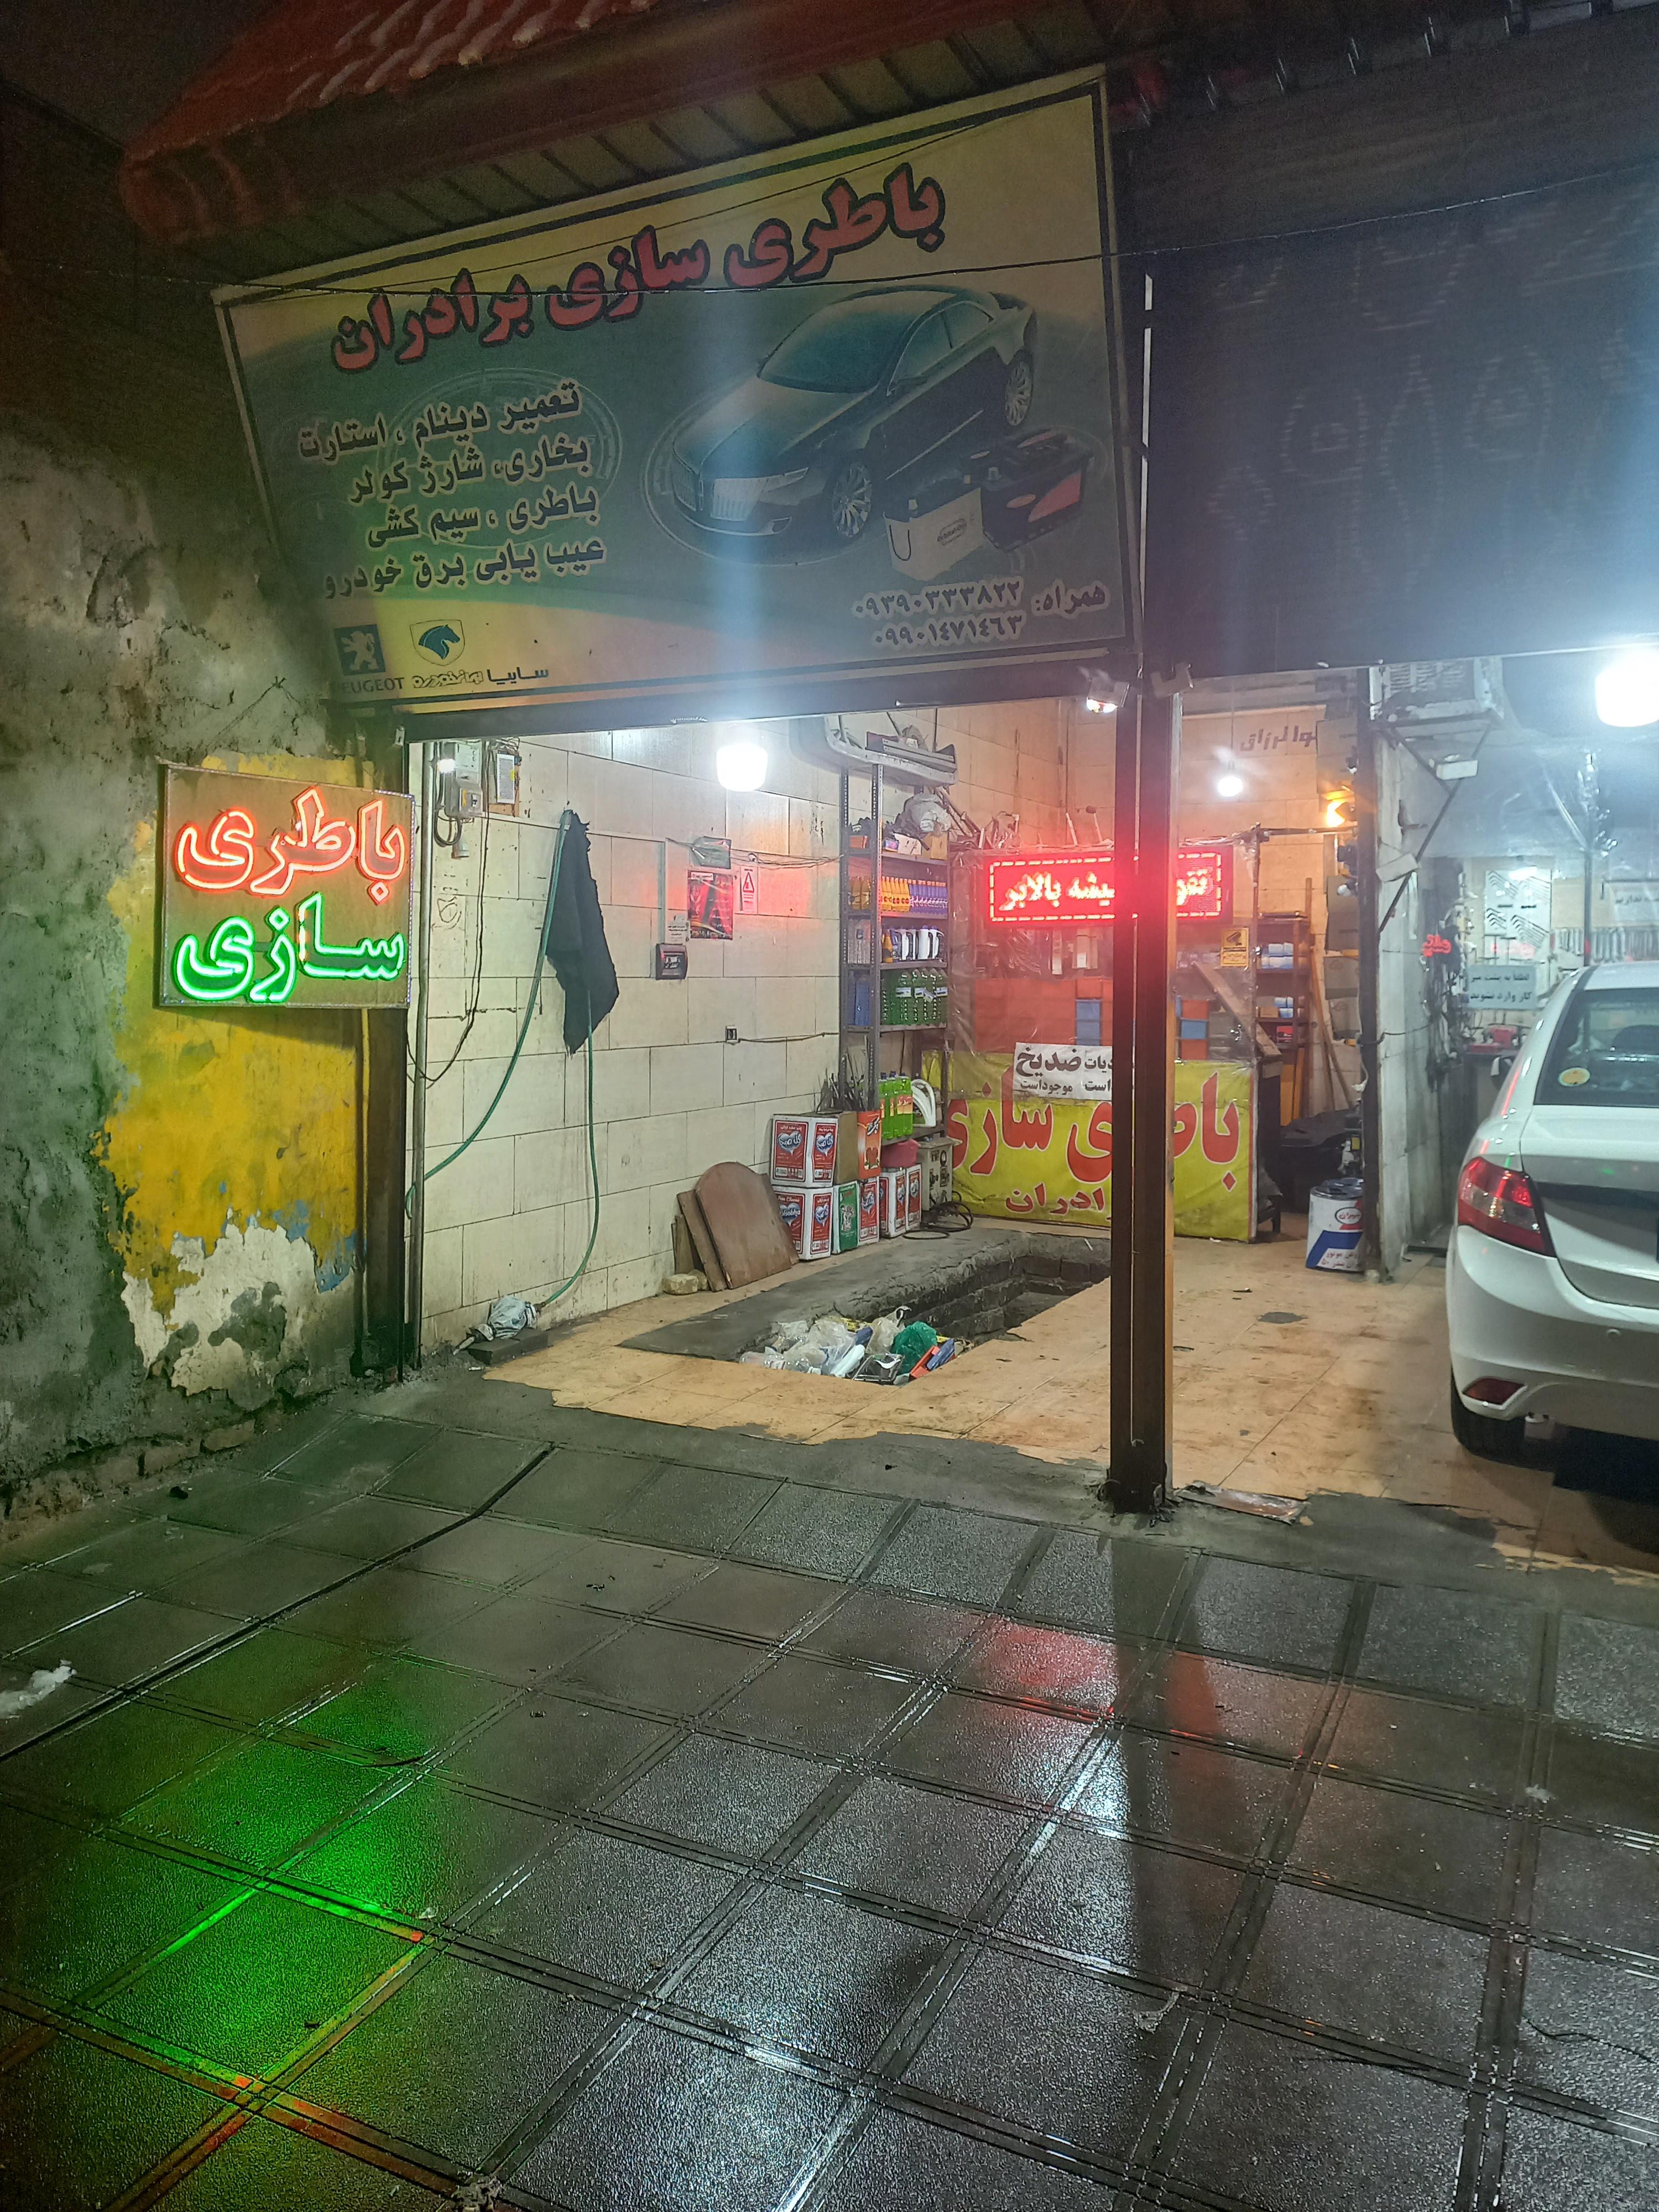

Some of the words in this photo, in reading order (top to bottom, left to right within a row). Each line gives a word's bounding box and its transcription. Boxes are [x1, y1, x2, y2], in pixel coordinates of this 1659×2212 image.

[723, 163, 946, 291] باطری
[544, 225, 711, 331] سازی
[331, 268, 536, 376] برادران
[499, 380, 582, 434] تعمیر
[299, 412, 388, 462] استارت
[349, 458, 410, 503] کولر
[420, 445, 486, 494] شارژ
[367, 507, 421, 549] کشی
[428, 508, 481, 542] سیم
[324, 555, 403, 599] خودرو
[413, 554, 467, 590] برق
[474, 541, 539, 583] یابی
[546, 539, 607, 576] عیب
[332, 677, 405, 695] EUGEOT
[487, 666, 549, 685] سایپا
[175, 785, 406, 905] باطری
[999, 870, 1062, 912] بالابر
[1067, 871, 1115, 907] یشه
[174, 892, 406, 1004] سازی
[1016, 1046, 1082, 1077] ضدیخ
[1005, 1182, 1112, 1222] ادران
